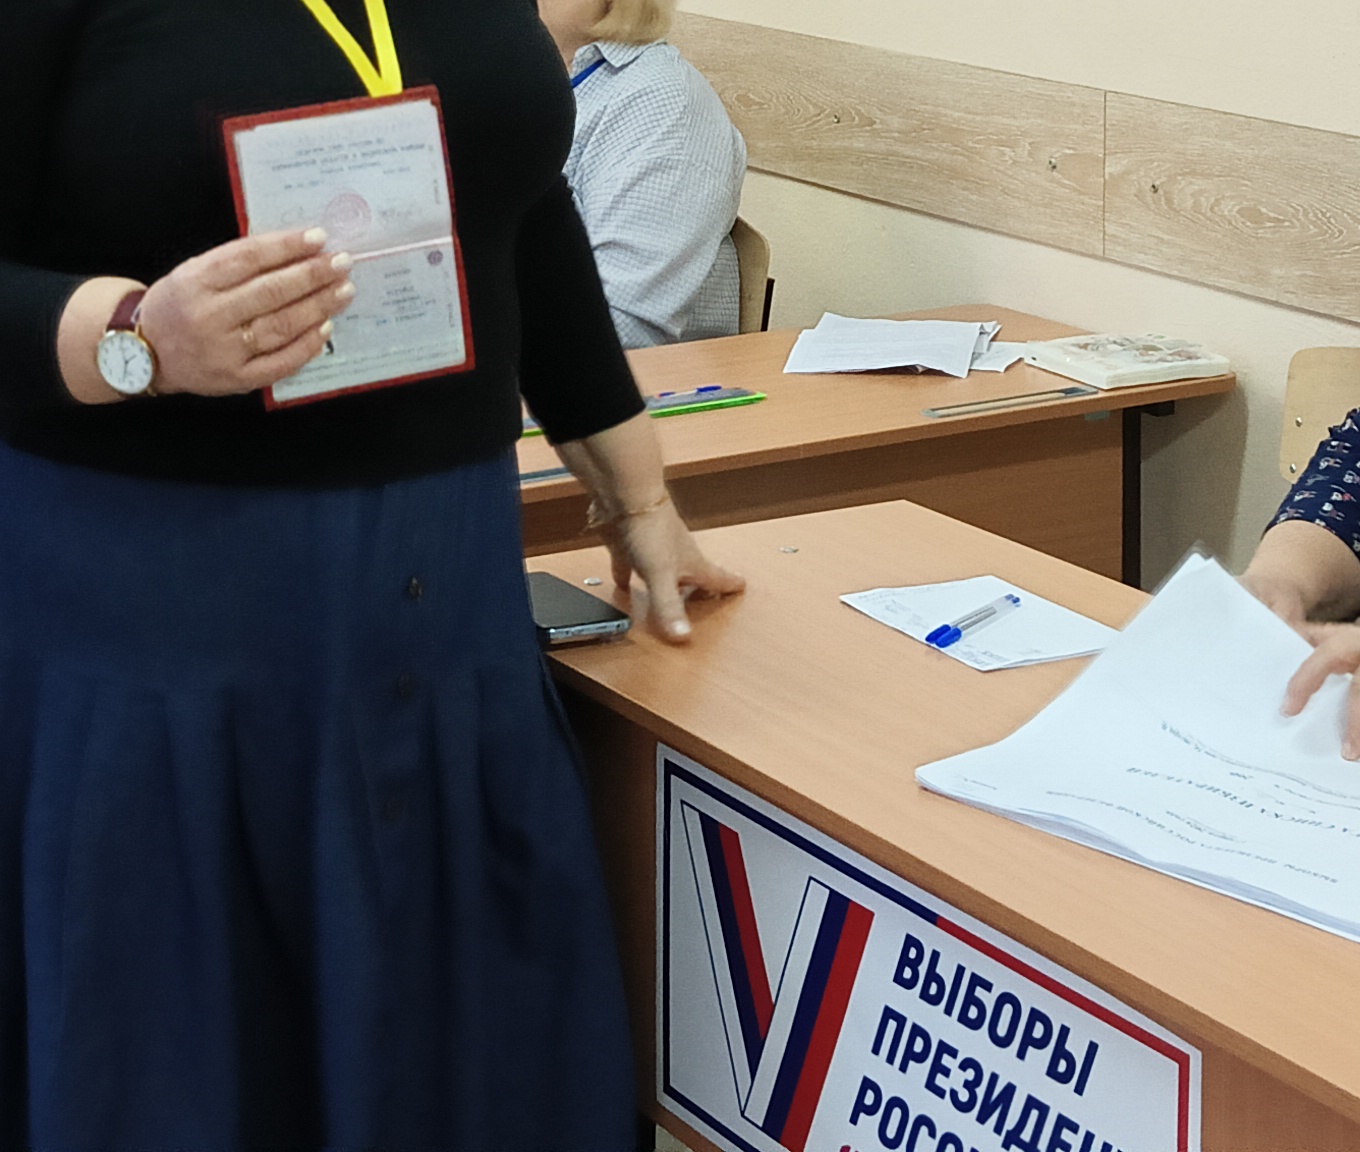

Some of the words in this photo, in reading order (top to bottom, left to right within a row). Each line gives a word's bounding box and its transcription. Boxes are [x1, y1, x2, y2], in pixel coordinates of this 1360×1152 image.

[870, 1004, 1123, 1152] ПРЕЗИДЕ
[892, 933, 1099, 1096] ВЫБОРЫ
[849, 1075, 979, 1152] РОС
